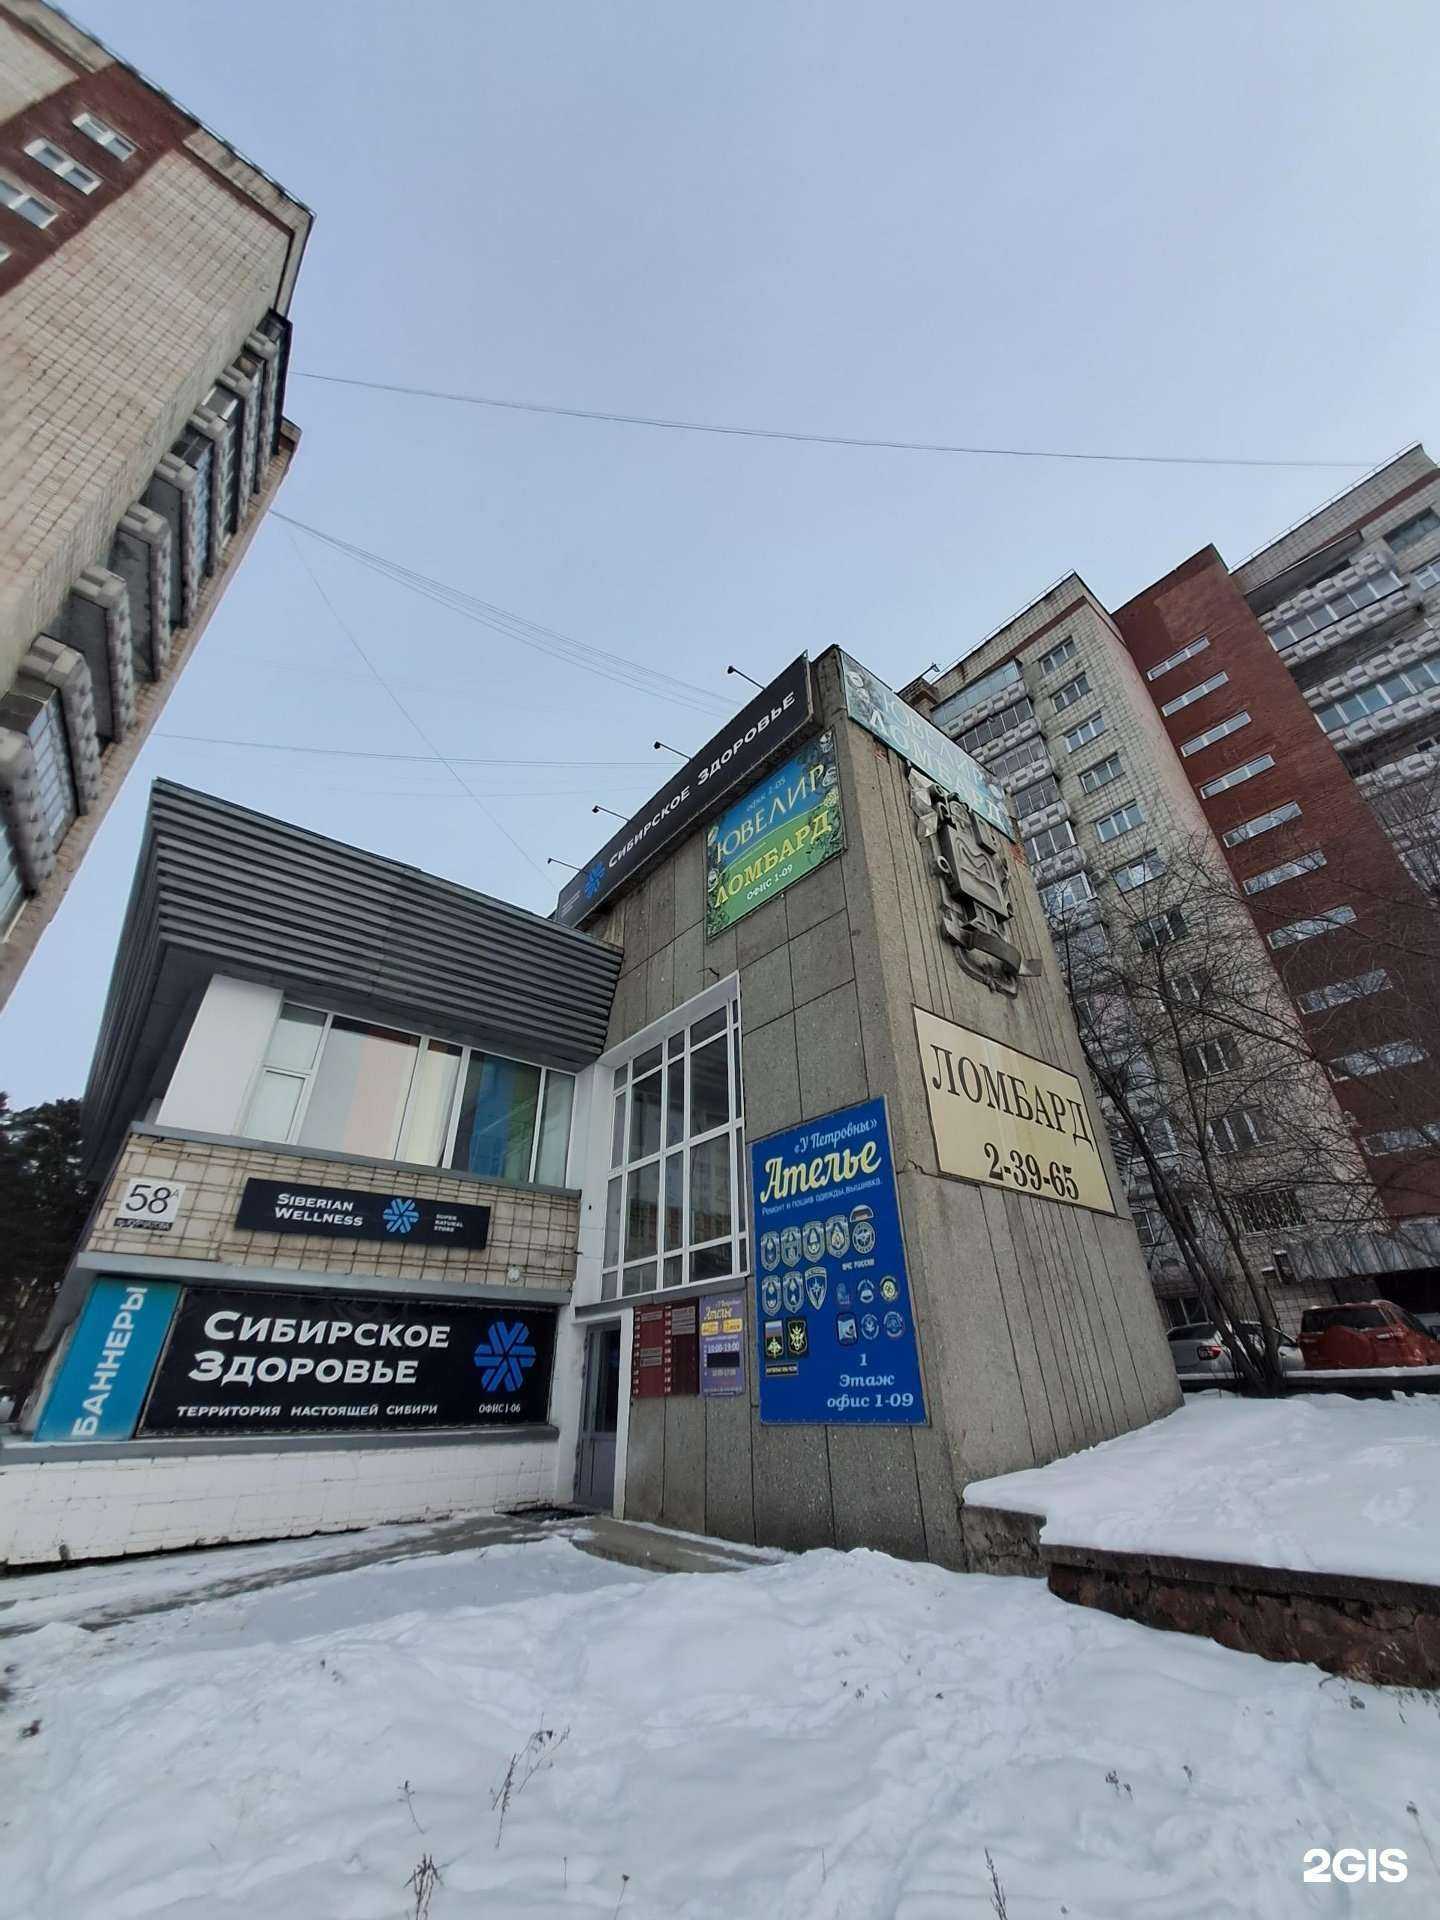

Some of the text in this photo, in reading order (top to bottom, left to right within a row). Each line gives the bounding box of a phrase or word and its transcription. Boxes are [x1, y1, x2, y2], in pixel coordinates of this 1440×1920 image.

[608, 786, 690, 868] СИБИРСКОЕ
[698, 691, 796, 786] ЗДОРОВЬЕ
[716, 764, 824, 864] ЮВЕЛИР
[714, 810, 833, 908] ЛОМБАРД
[929, 1043, 1095, 1153] ЛОМБАРД
[760, 1141, 882, 1203] Ателье
[984, 1142, 1079, 1200] 2-39-65
[275, 1207, 364, 1227] WELLNESS
[277, 1193, 353, 1211] SIBERIAN
[204, 1311, 450, 1348] СИБИРСКОЕ
[71, 1287, 147, 1437] БАННЕРЫ
[188, 1350, 418, 1388] ЗДОРОВЬЕ
[860, 1353, 867, 1366] 1
[839, 1374, 895, 1387] Этаж
[177, 1404, 438, 1418] ТЕРРИТОРИЯ НАСТОЯЩЕЙ СИБИРИ
[827, 1393, 914, 1412] офис 1-09
